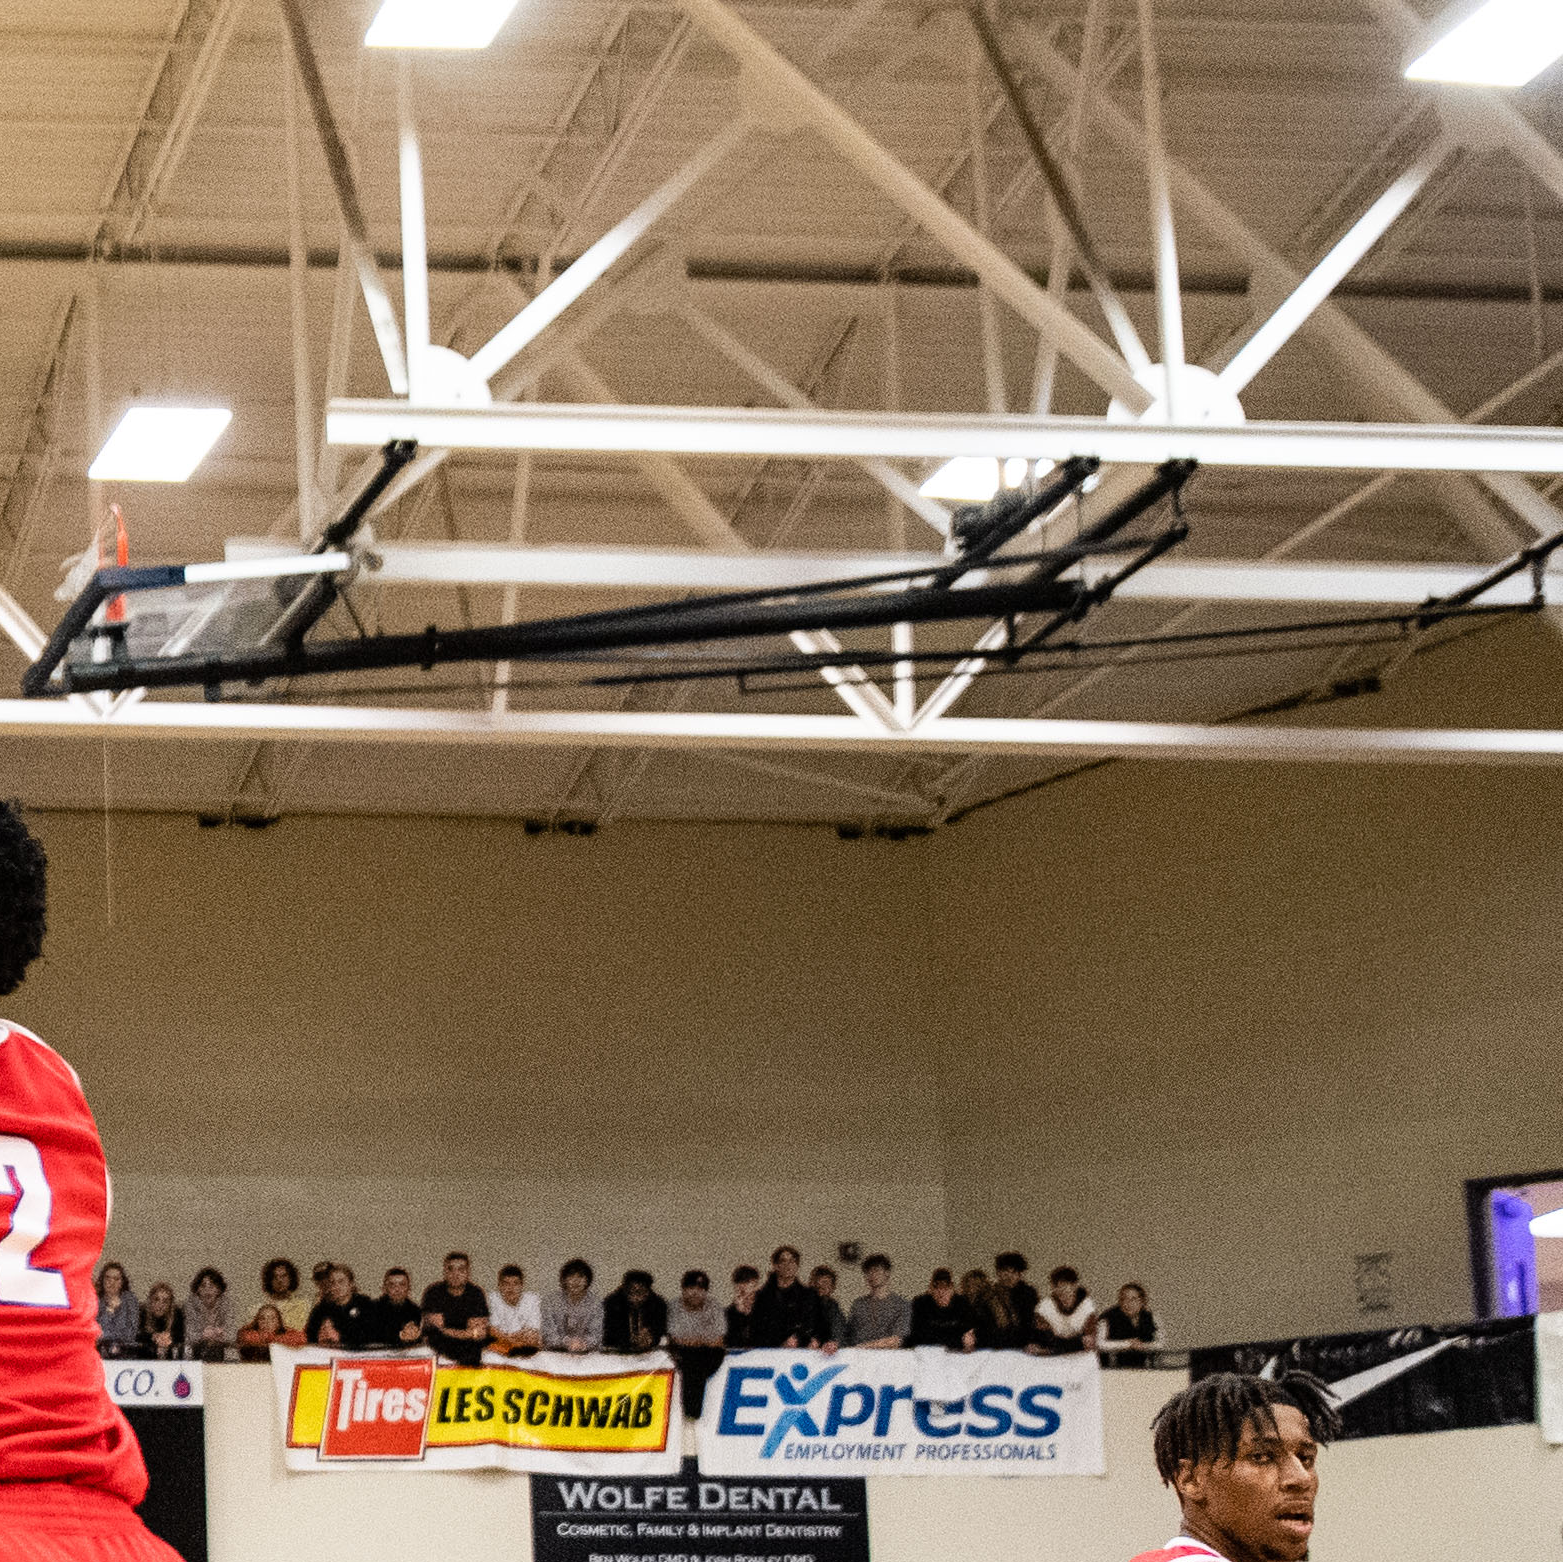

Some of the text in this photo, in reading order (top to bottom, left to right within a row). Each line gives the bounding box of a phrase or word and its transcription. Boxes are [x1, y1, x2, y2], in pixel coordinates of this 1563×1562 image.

[336, 1368, 655, 1432] Tires LES SCHWAB
[783, 1443, 1058, 1461] EMPLOYMENT PROFESSIONALS
[557, 1481, 844, 1512] WOLFE DENTAL
[636, 1523, 686, 1538] FAMILY
[687, 1523, 701, 1538] &
[702, 1524, 763, 1538] IMPLANT
[765, 1523, 844, 1539] DENTISTRY
